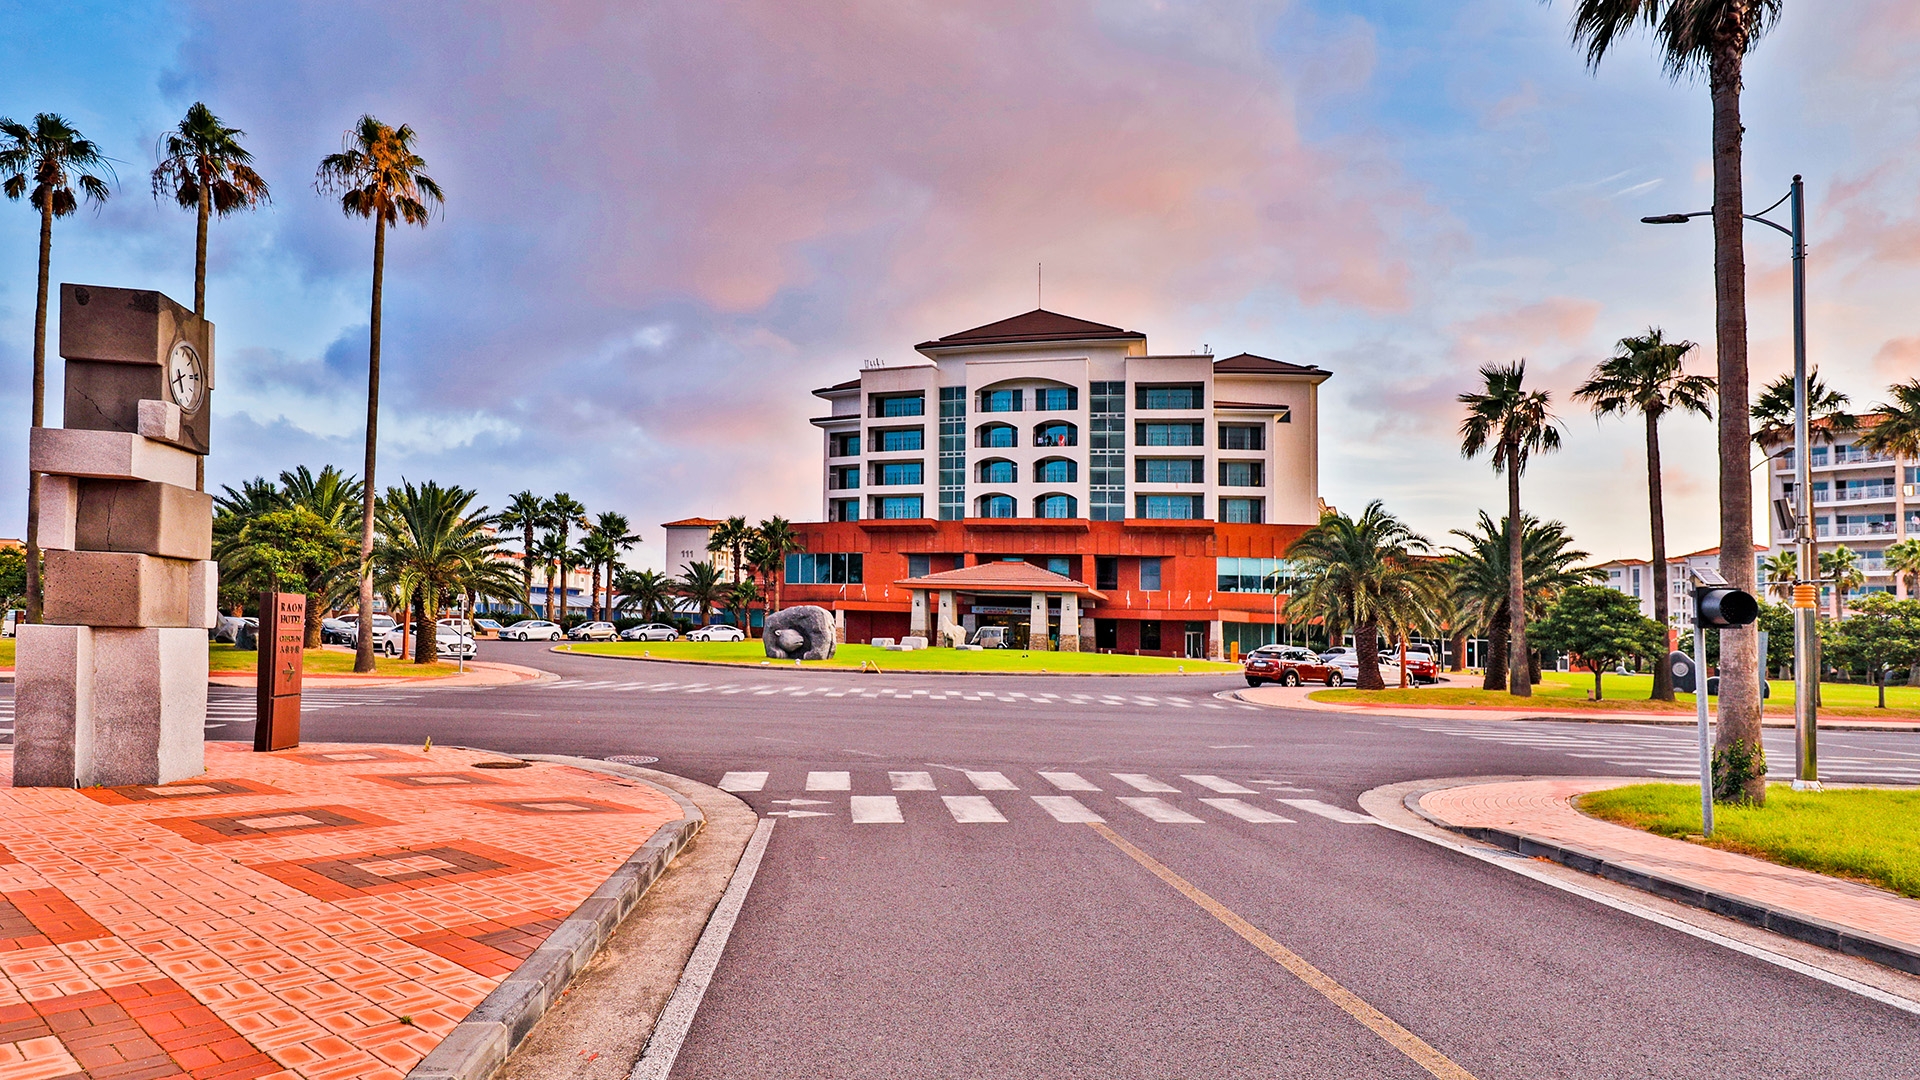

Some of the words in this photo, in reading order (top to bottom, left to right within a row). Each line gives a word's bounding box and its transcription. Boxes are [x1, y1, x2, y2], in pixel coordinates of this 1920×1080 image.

[681, 550, 694, 558] 111
[280, 602, 303, 612] RAON
[280, 614, 303, 624] HOTEL
